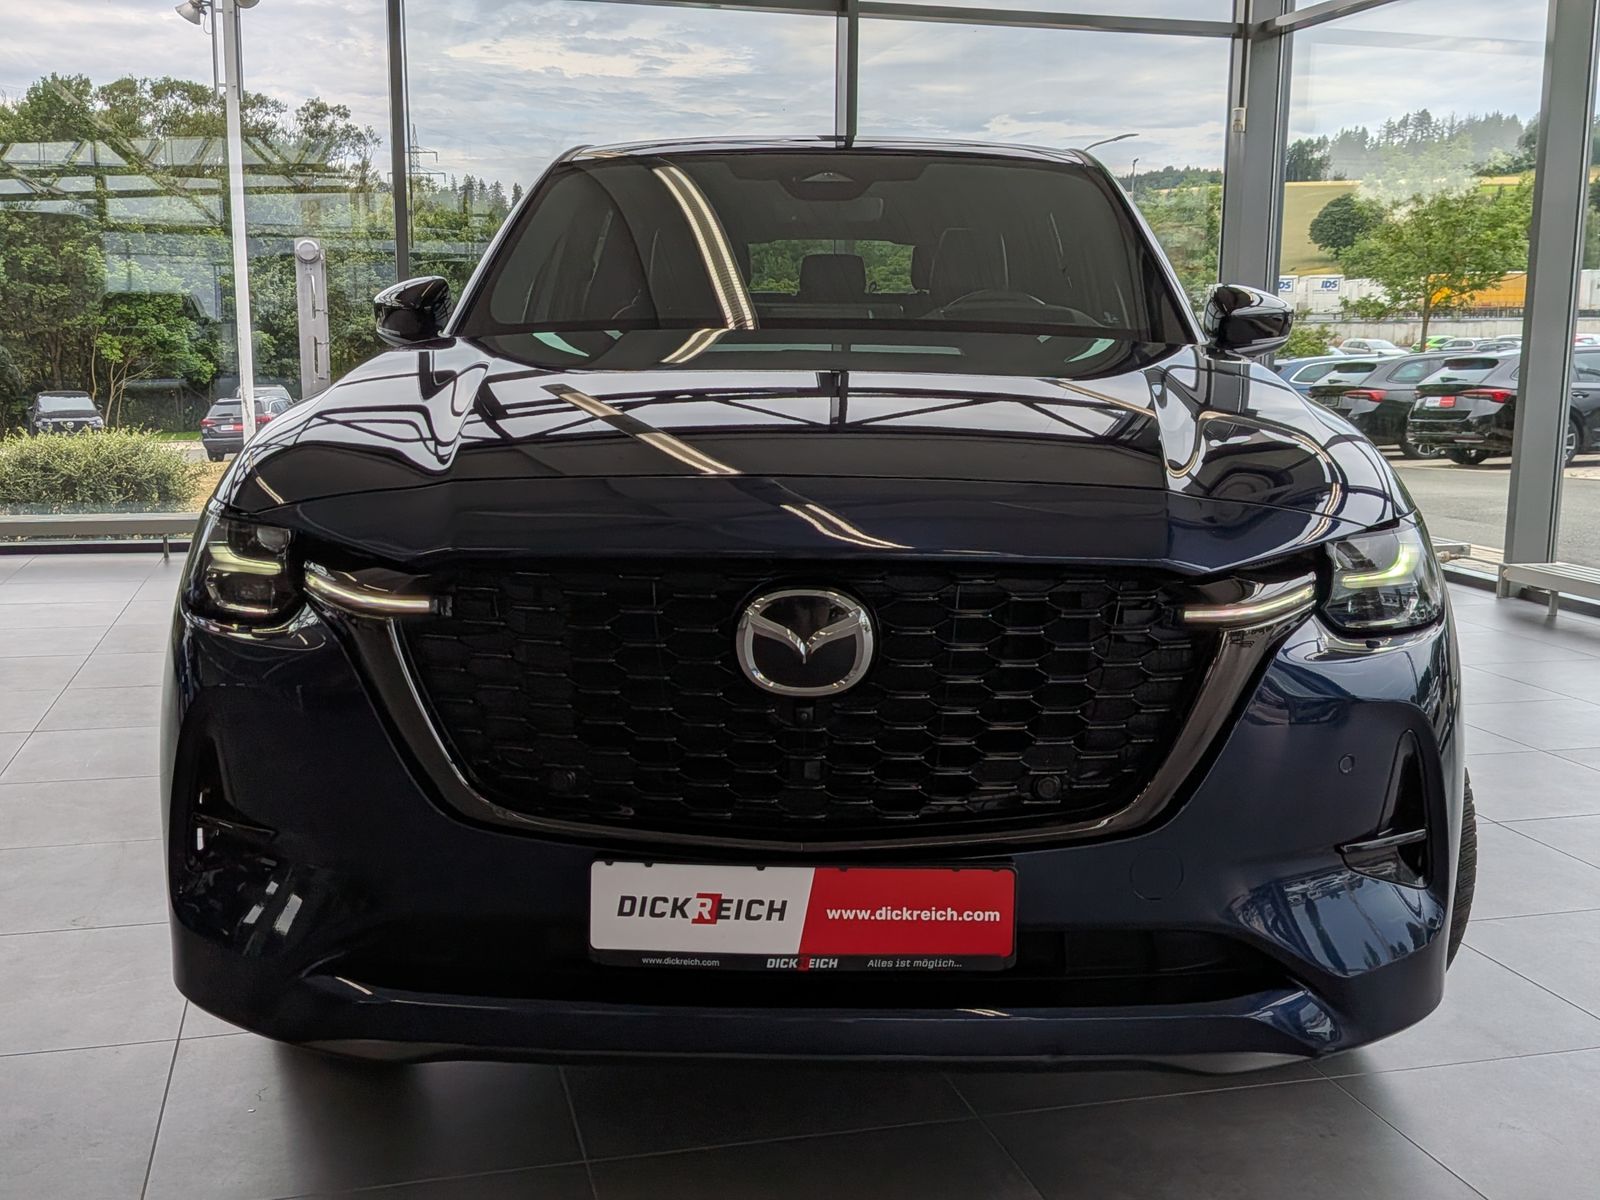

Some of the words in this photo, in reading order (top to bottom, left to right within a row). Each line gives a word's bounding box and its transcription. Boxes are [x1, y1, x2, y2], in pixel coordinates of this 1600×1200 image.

[1278, 281, 1291, 289] DS
[1321, 280, 1338, 289] IDS
[616, 893, 788, 924] DICKREICH
[826, 907, 1001, 922] www.dickreich.com
[641, 956, 720, 967] www.dickreich.com
[766, 958, 838, 969] DICKEICH
[867, 959, 893, 968] Alles
[896, 959, 911, 968] ist
[913, 958, 963, 970] möglich...
